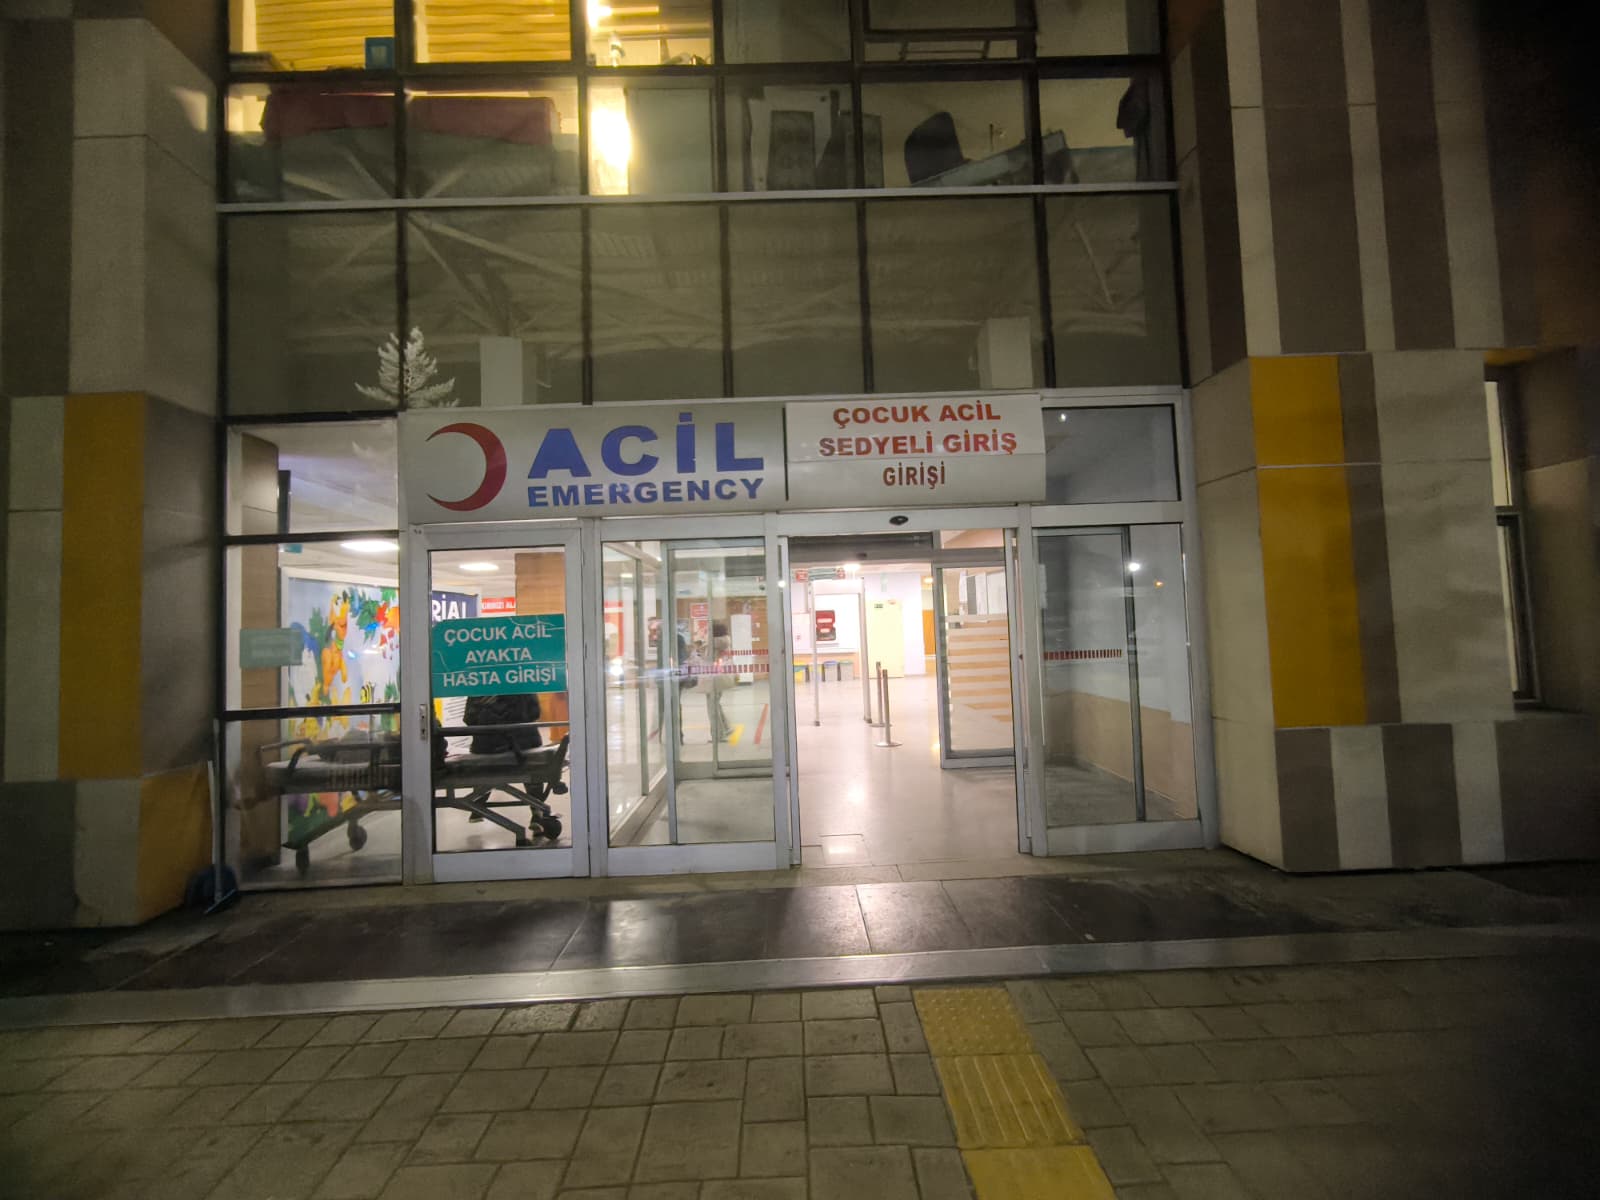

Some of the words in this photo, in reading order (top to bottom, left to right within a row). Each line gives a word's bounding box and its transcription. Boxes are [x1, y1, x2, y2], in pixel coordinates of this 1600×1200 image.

[832, 404, 931, 430] ÇOCUK
[938, 400, 1002, 422] ACİL
[527, 411, 764, 479] ACİL
[818, 430, 934, 457] SEDYELİ
[942, 428, 1018, 456] GİRİŞ
[882, 460, 946, 490] GİRİŞİ
[527, 477, 765, 508] EMERGENCY
[443, 626, 508, 647] ÇOCUK
[511, 623, 553, 640] ACİL
[464, 647, 533, 664] AYAKTA
[442, 671, 502, 688] HASTA
[504, 663, 557, 686] GİRİŞİ
